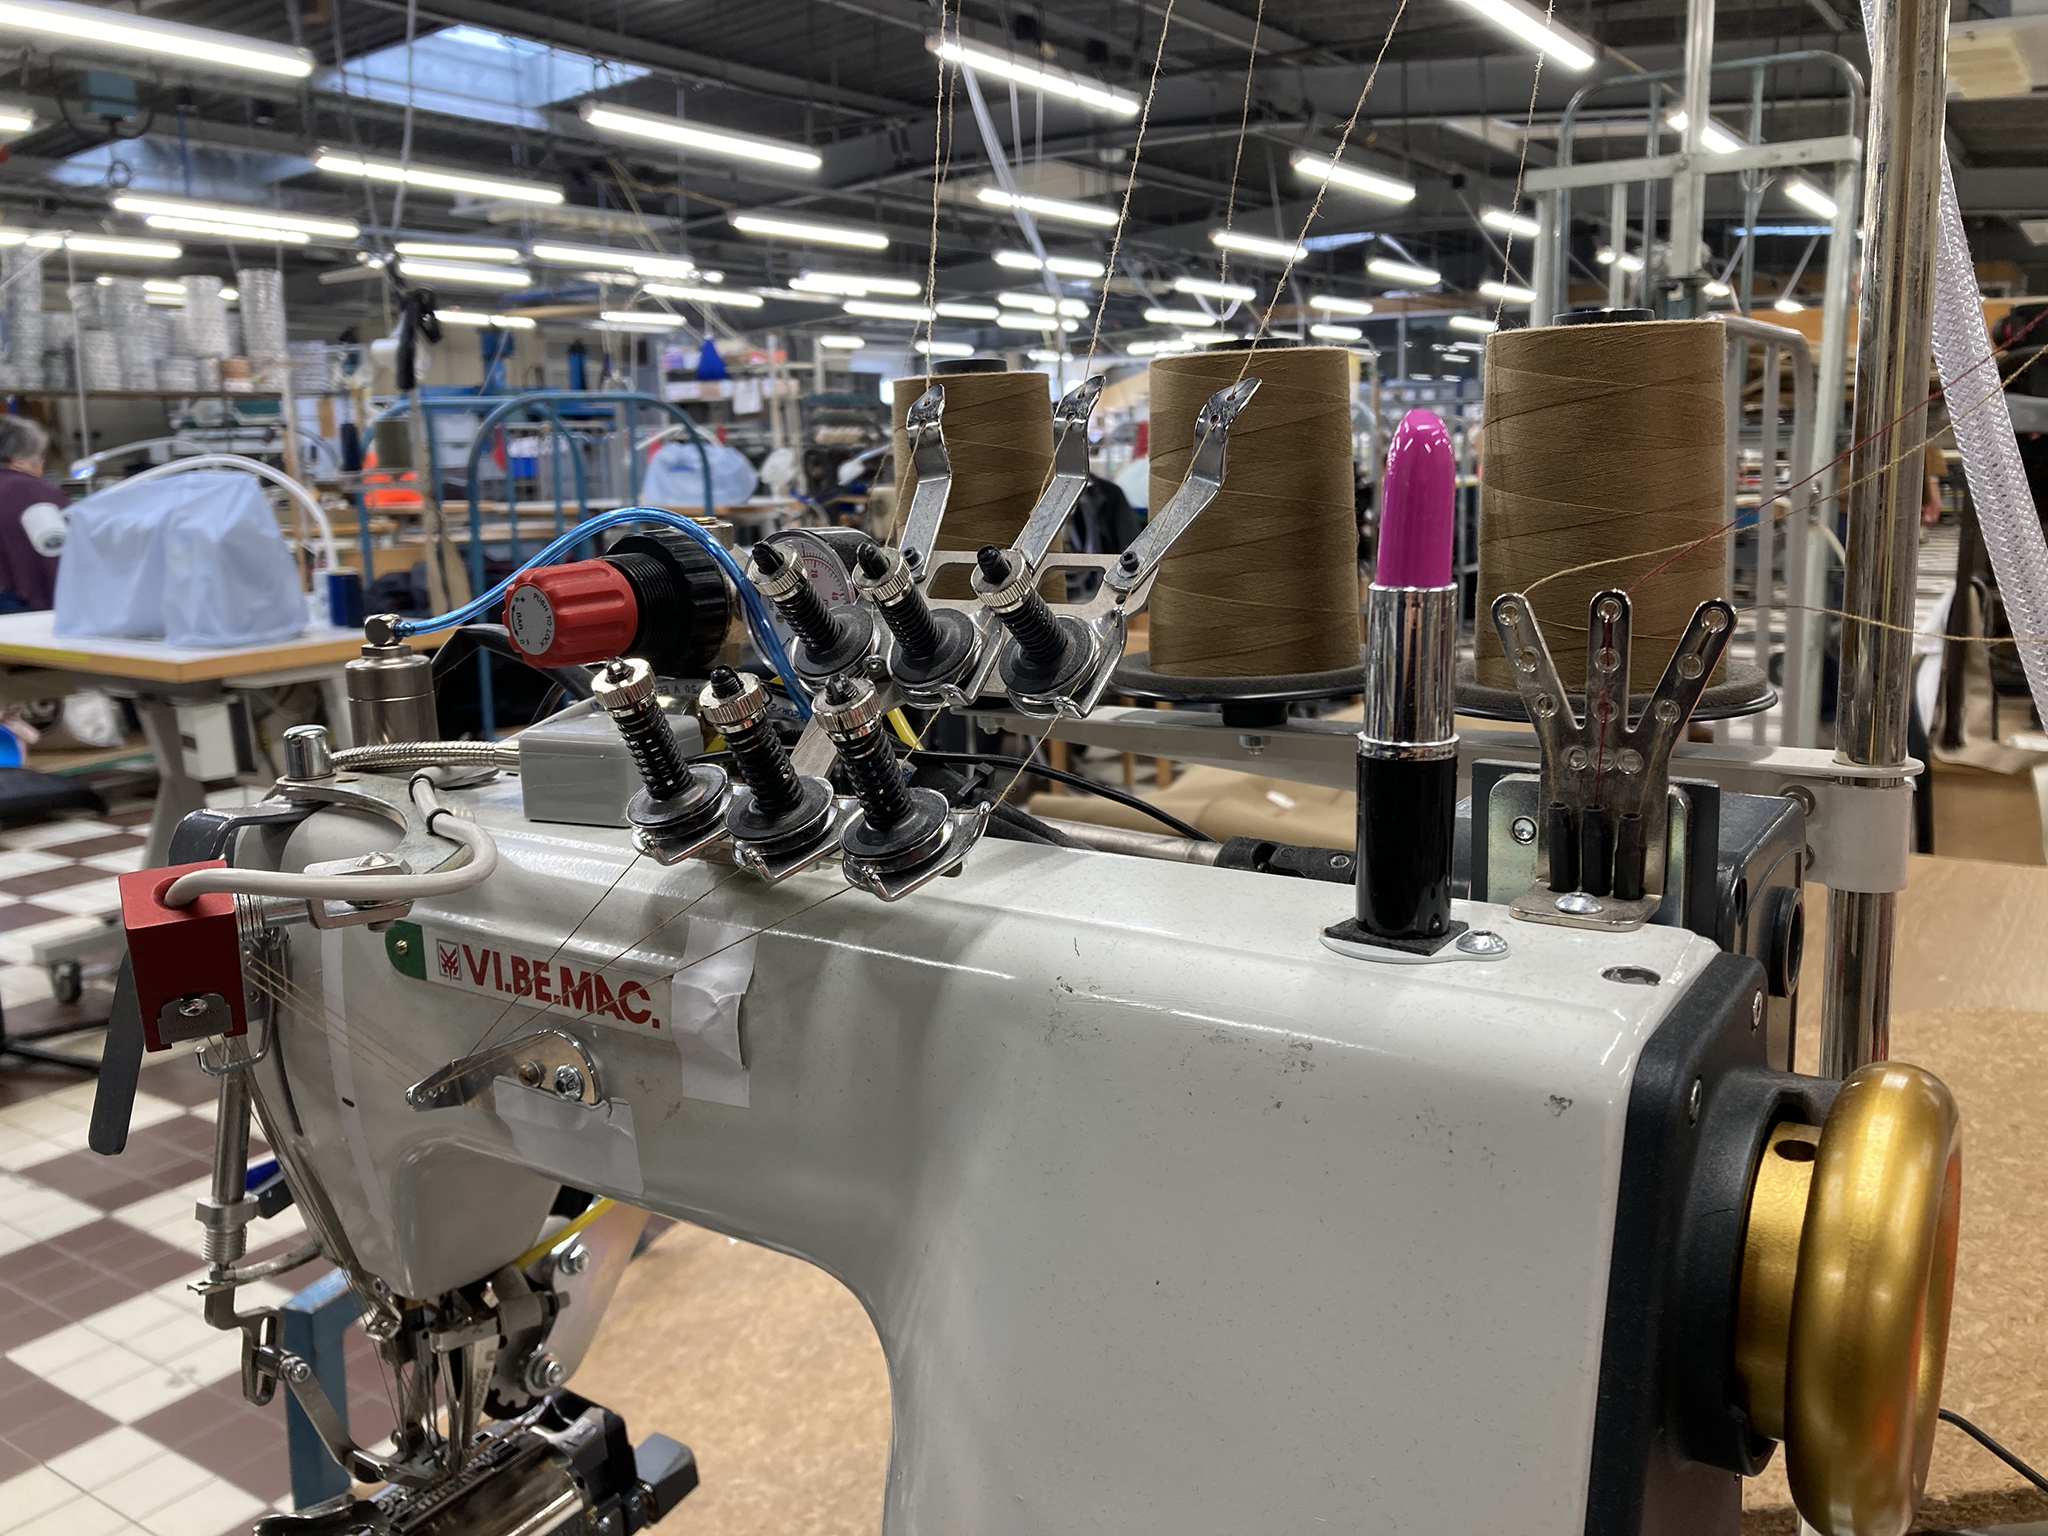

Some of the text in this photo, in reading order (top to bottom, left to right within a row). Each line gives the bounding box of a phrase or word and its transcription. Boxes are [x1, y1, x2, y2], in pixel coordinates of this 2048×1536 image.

[516, 612, 524, 630] BAR
[533, 592, 553, 648] PUSH TO LOCK
[461, 944, 661, 1029] VI.BE.MAC.
